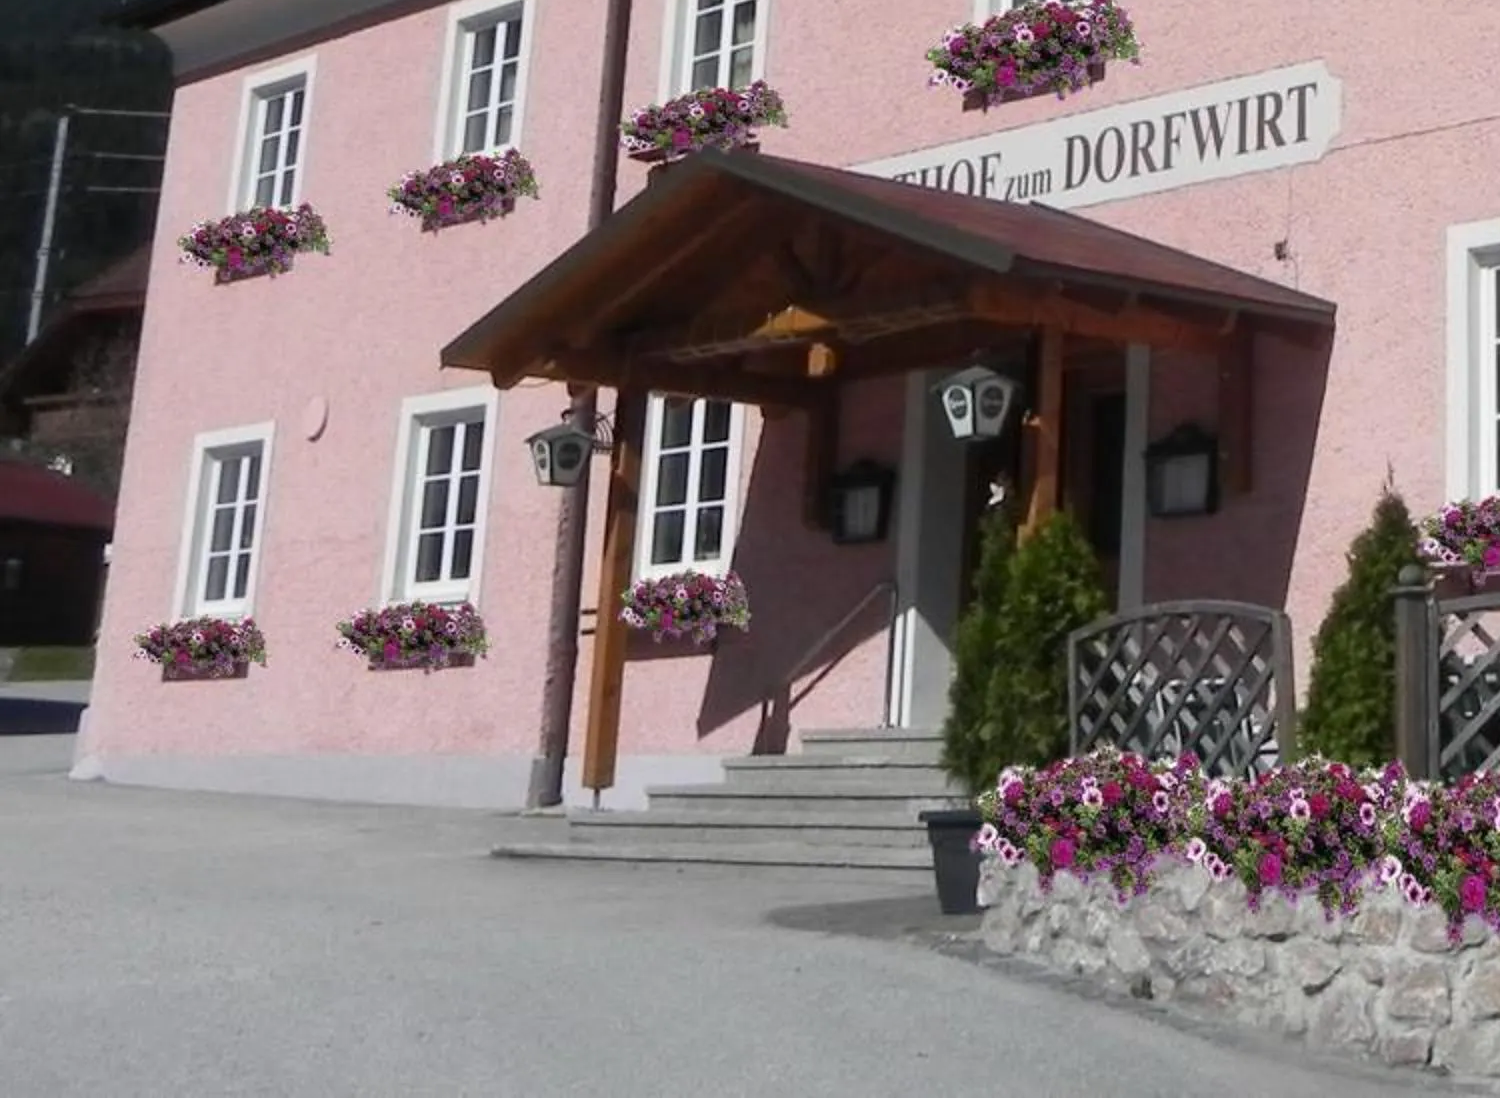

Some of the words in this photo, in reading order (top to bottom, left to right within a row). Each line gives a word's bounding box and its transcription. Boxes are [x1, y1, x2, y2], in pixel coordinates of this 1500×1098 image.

[893, 152, 1002, 200] OF
[1004, 168, 1053, 203] zum
[1064, 81, 1318, 191] DORFWIRT
